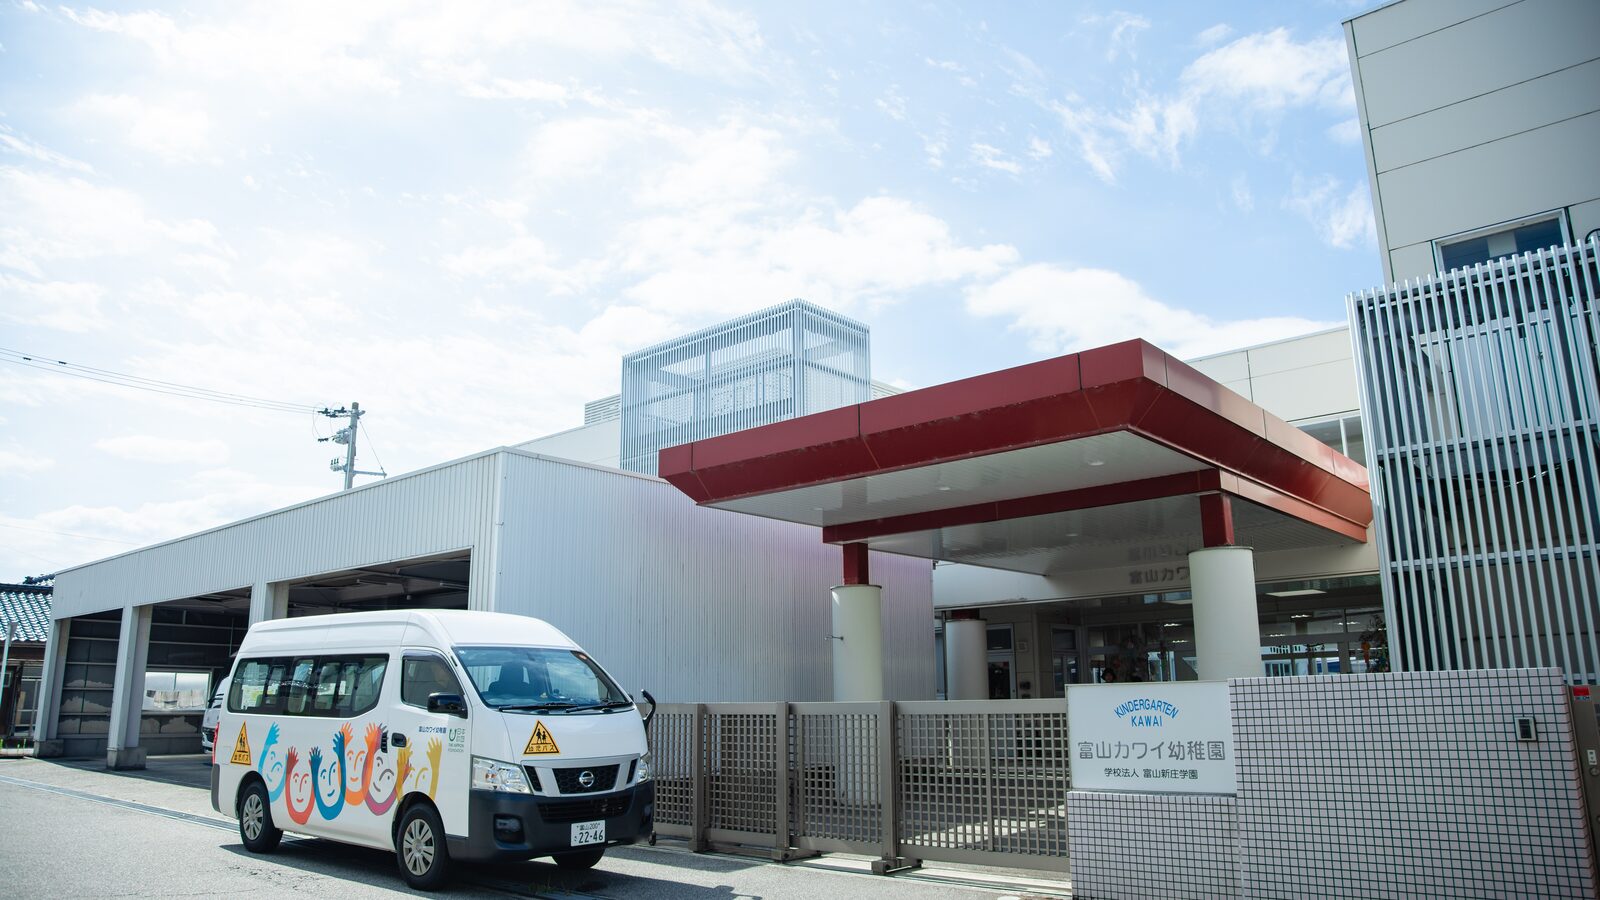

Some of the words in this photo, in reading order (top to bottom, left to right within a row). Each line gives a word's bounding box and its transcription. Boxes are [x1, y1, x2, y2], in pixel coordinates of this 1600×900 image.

[1114, 698, 1179, 719] KINDERGARTEN
[1131, 715, 1163, 727] KAWAI
[1078, 740, 1226, 761] 富山カワイ幼稚園
[1104, 767, 1139, 778] 学校法人
[1143, 768, 1199, 780] 富山新庄学園
